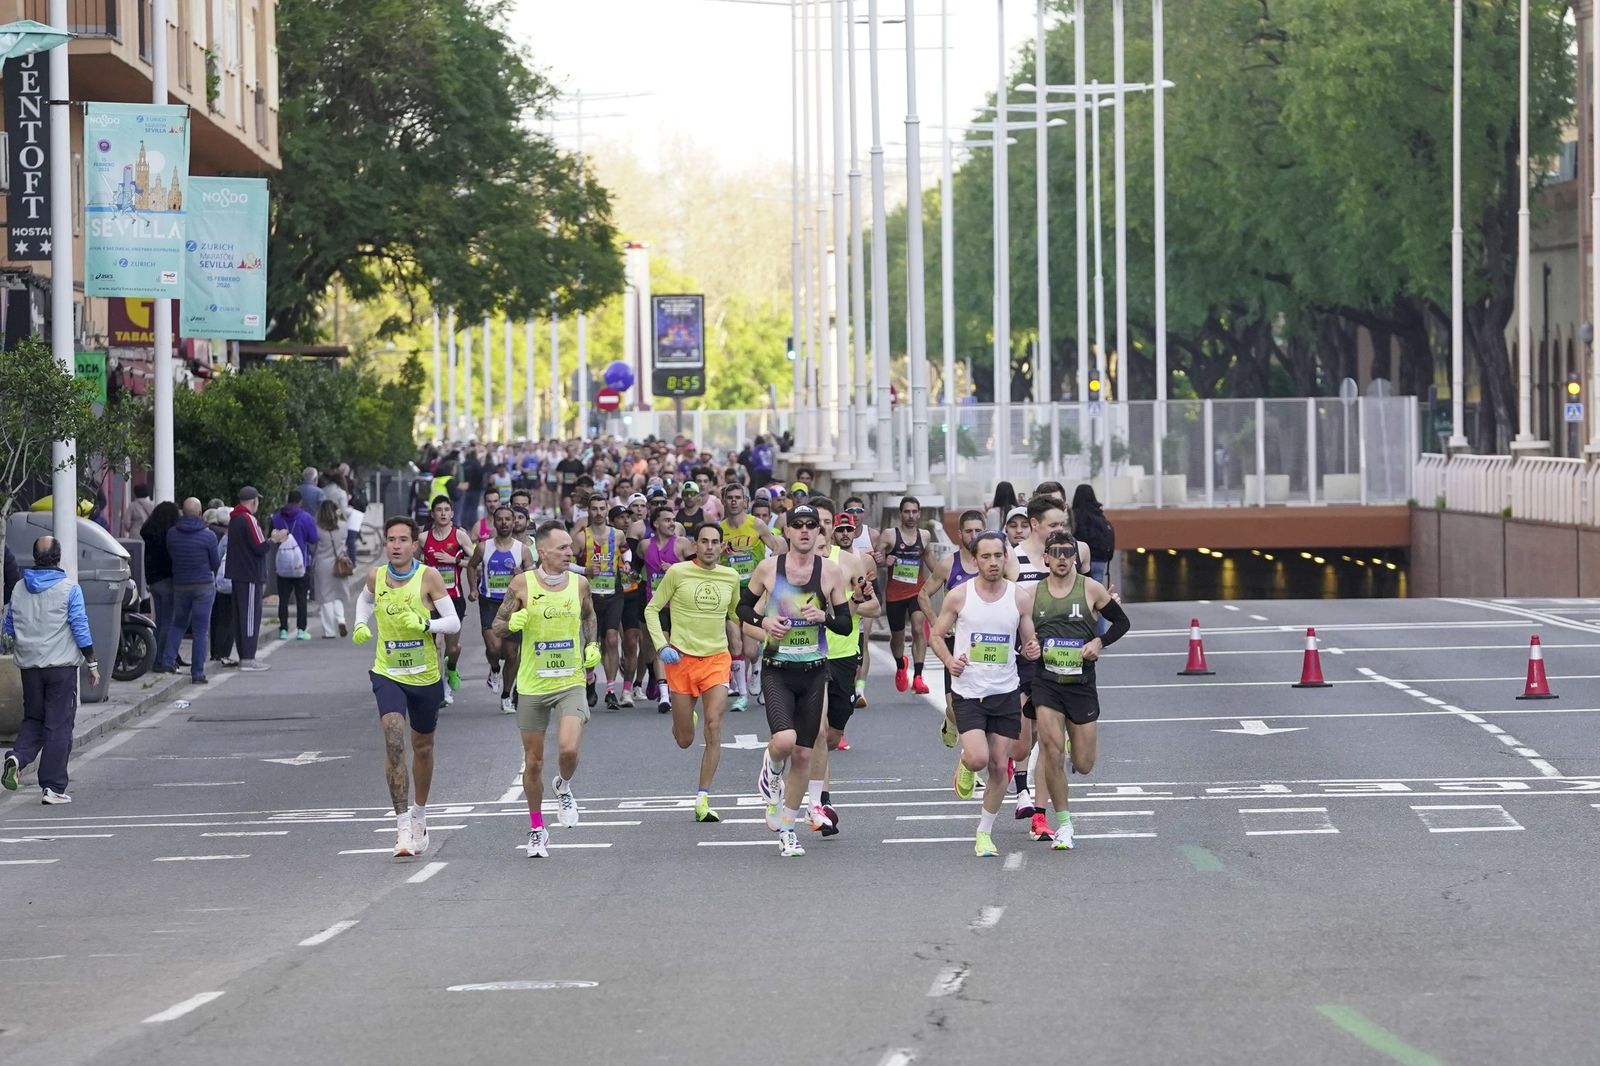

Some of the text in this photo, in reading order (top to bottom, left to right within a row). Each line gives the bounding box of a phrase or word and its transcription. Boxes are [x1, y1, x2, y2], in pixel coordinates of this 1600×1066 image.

[18, 52, 42, 218] JENTOFT
[91, 218, 182, 239] SEVILLA
[114, 331, 175, 342] TABAC
[667, 376, 700, 390] 8:55
